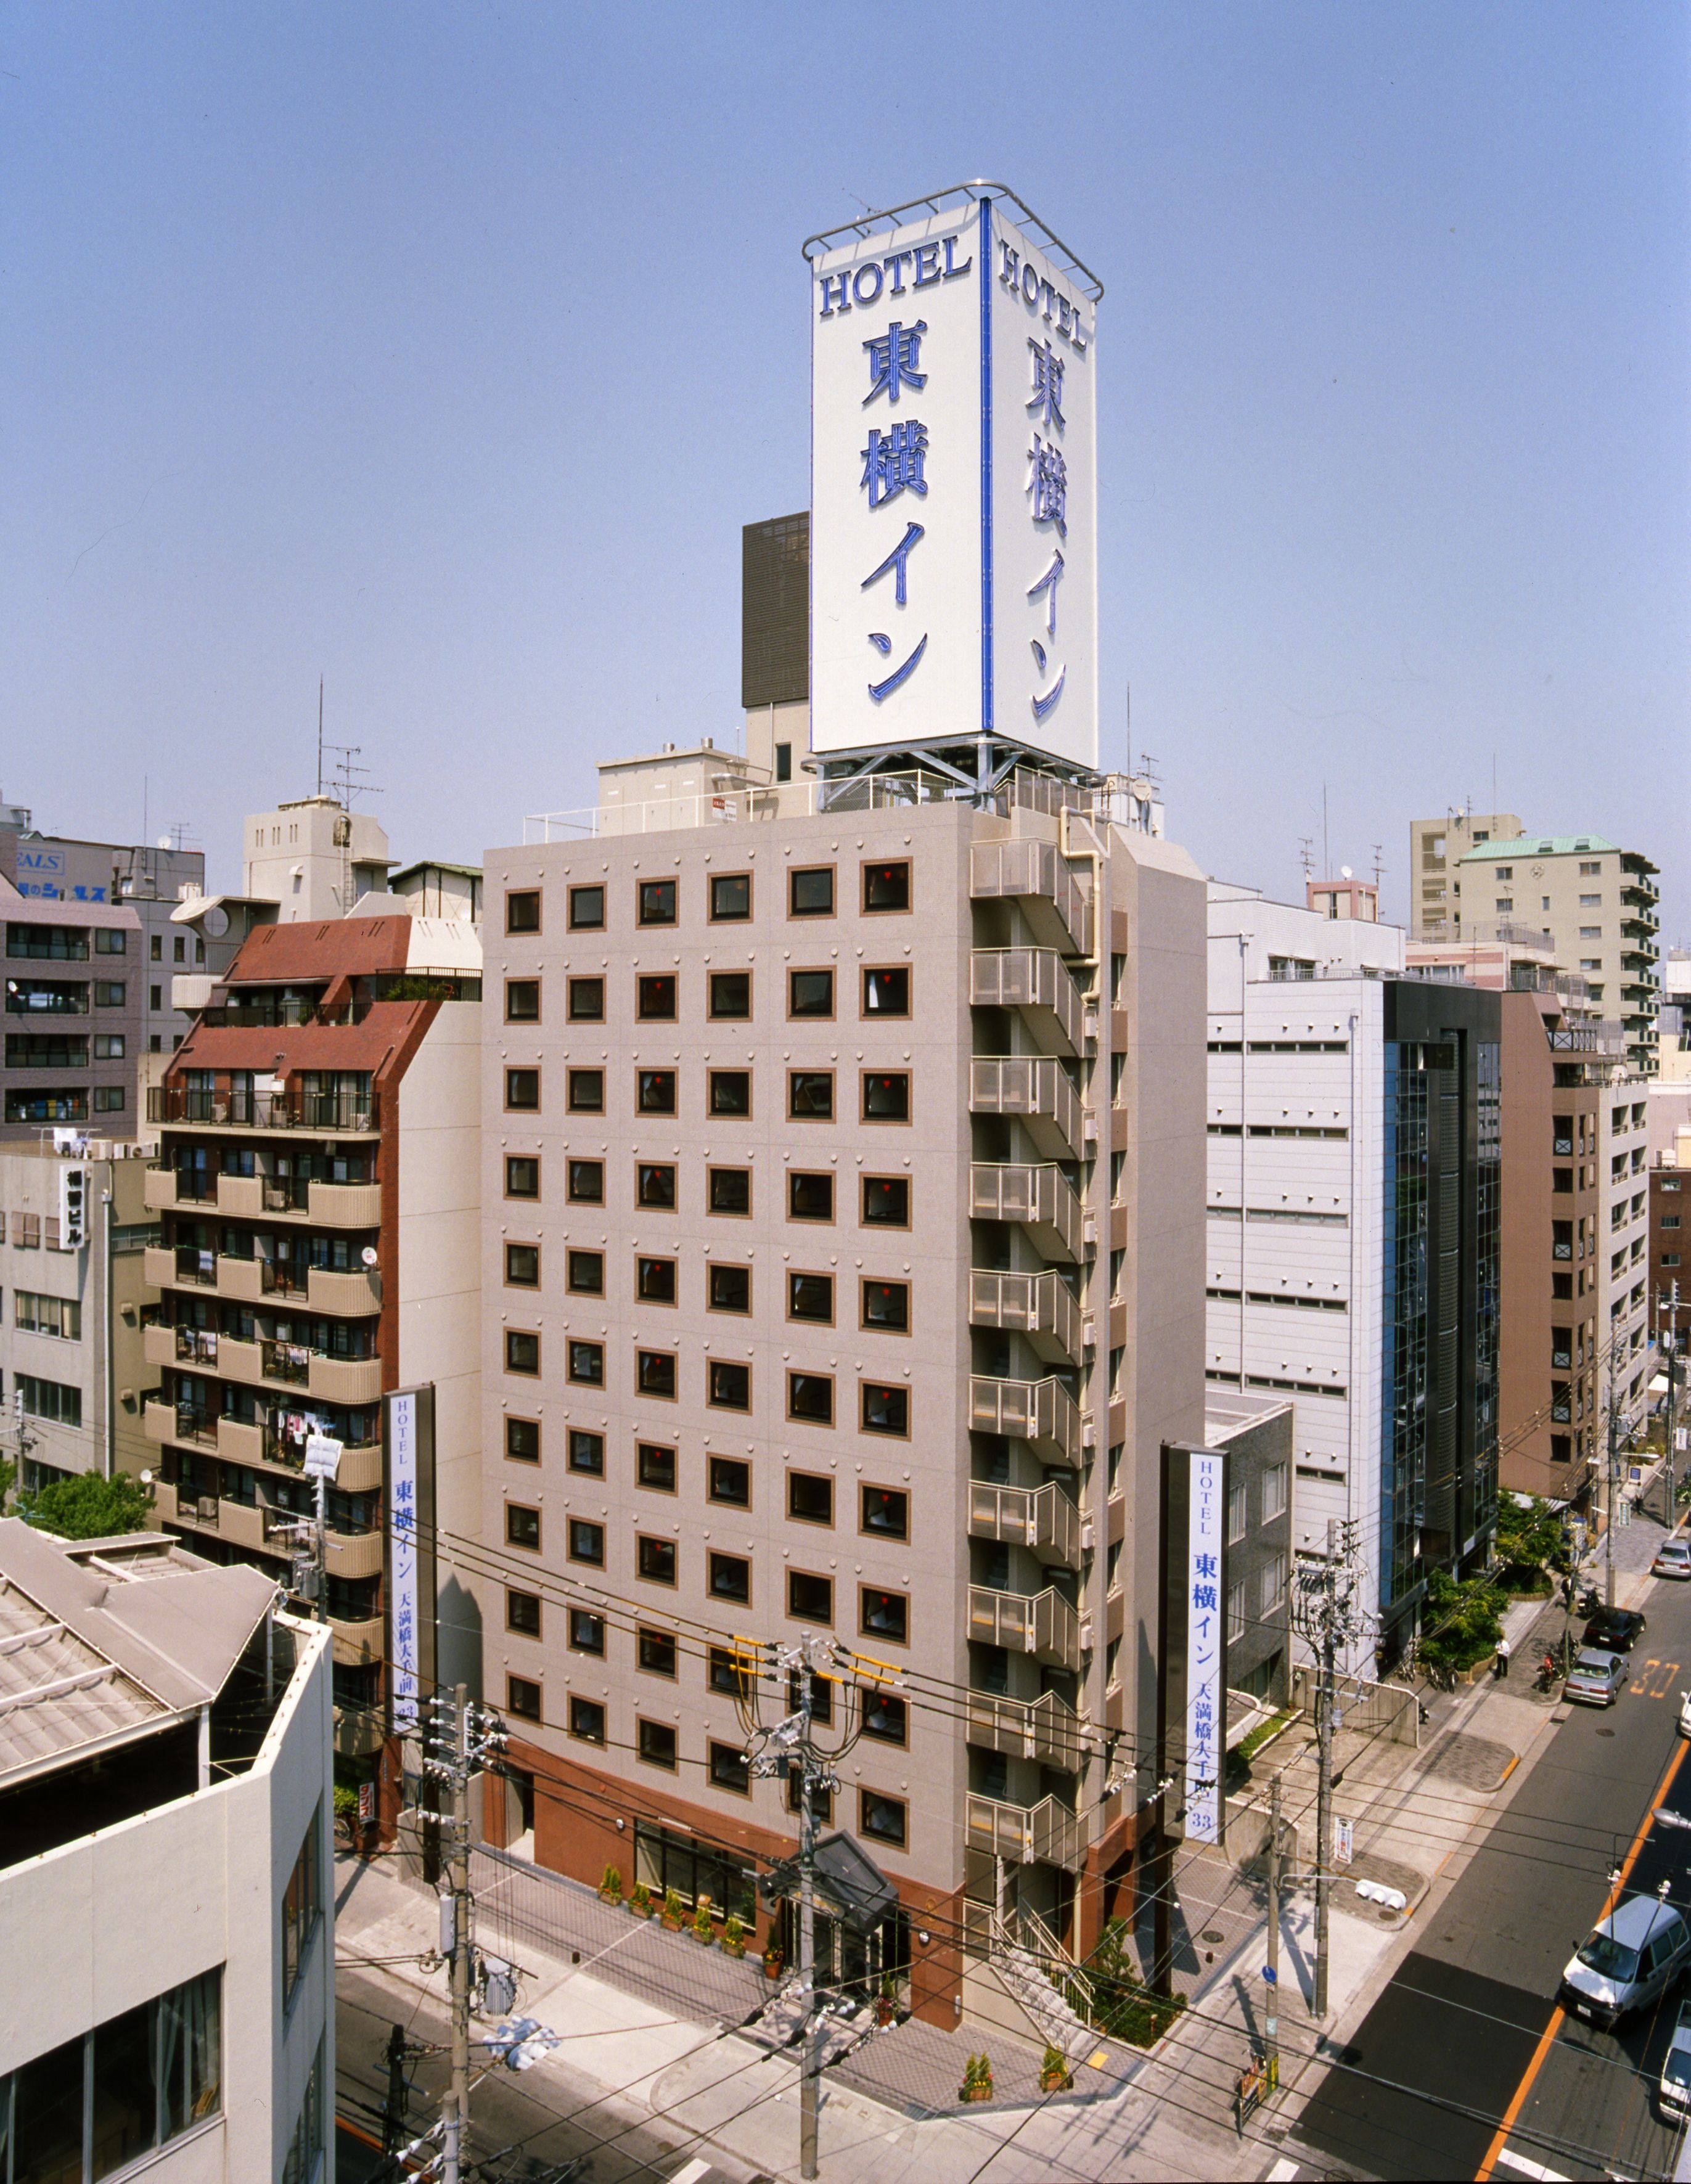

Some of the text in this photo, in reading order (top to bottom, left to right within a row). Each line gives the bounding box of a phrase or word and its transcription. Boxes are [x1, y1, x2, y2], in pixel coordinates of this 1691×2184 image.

[819, 235, 973, 316] HOTEL
[998, 238, 1087, 351] HOTEL
[860, 318, 928, 701] 東横イン
[1025, 336, 1068, 718] 東横イン
[398, 1401, 407, 1465] HOTEL
[395, 1481, 413, 1579] 東横イン
[1200, 1461, 1212, 1536] HOTEL
[399, 1591, 412, 1693] 天満橋大手前
[1192, 1553, 1217, 1664] 東横イン
[1629, 1659, 1680, 1698] 30
[1192, 1812, 1211, 1829] 33
